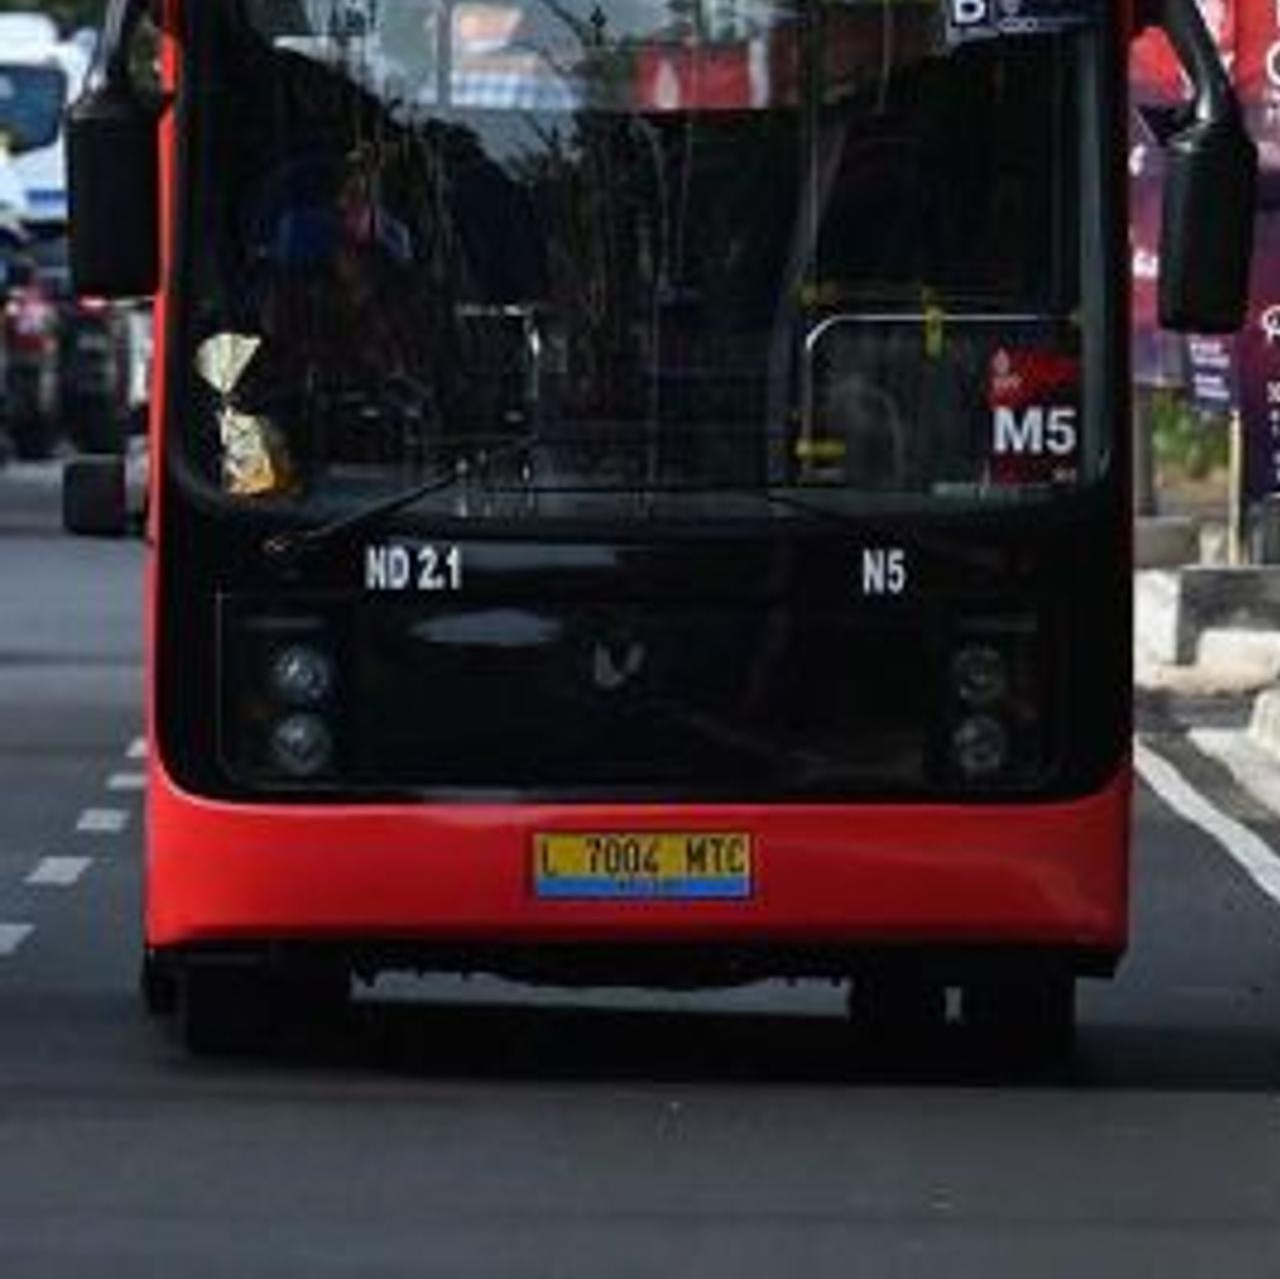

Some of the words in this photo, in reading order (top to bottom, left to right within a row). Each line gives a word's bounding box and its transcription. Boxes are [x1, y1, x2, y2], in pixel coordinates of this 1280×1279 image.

[994, 405, 1076, 455] M5
[365, 544, 410, 591] ND
[863, 549, 906, 595] N5
